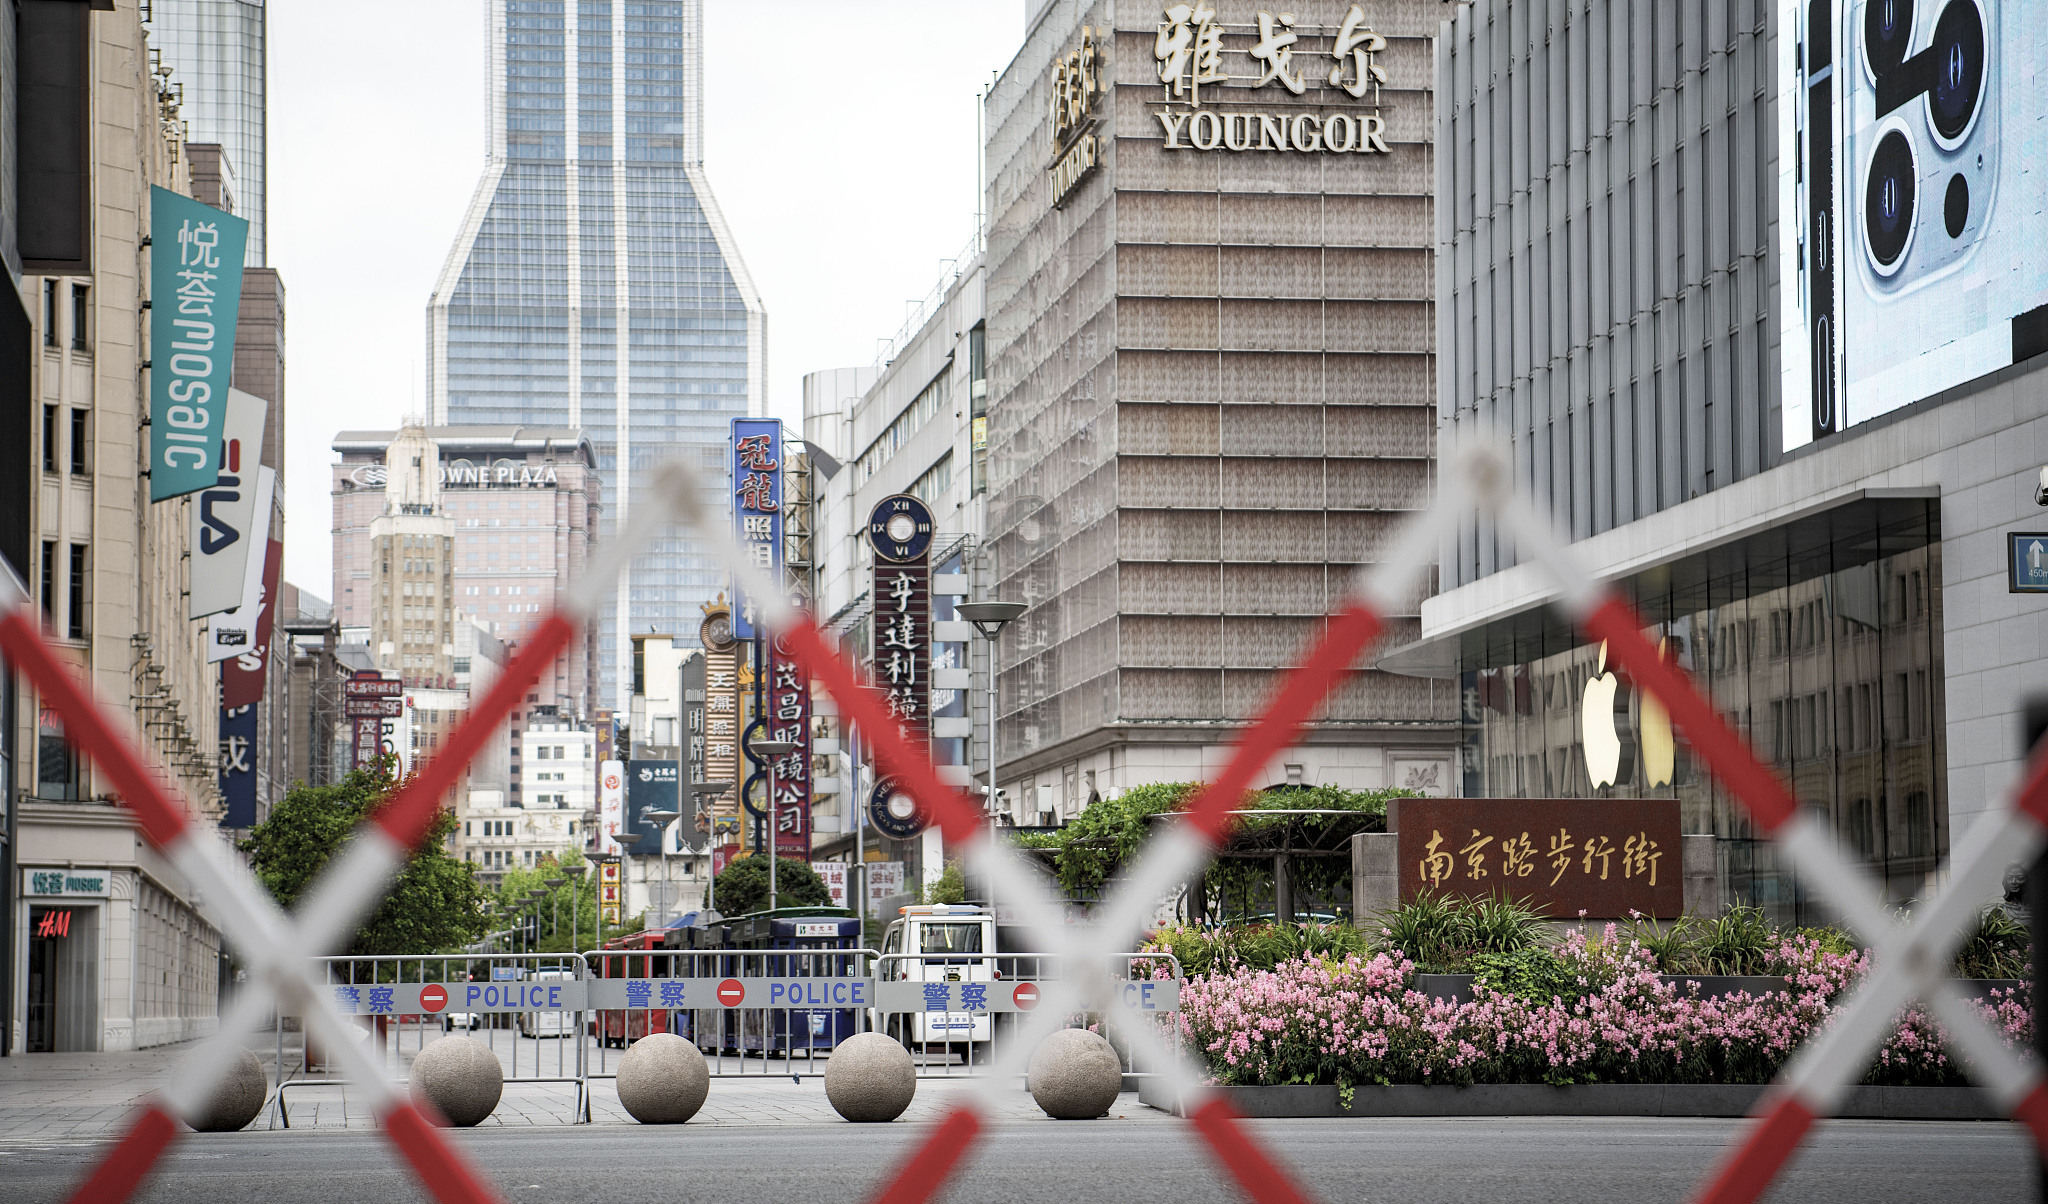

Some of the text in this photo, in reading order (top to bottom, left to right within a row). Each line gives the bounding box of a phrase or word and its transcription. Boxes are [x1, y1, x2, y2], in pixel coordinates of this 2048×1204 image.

[1154, 3, 1390, 108] 雅戈尔
[1155, 112, 1393, 154] YOUNGOR
[176, 219, 220, 318] 悦荟
[498, 466, 558, 484] PLAZA
[892, 501, 910, 511] XII
[872, 523, 885, 533] IX
[918, 523, 930, 533] III
[895, 546, 908, 555] VI
[386, 702, 401, 715] 9F
[711, 672, 731, 759] 王開照相
[1419, 828, 1663, 889] 南京路步行街
[38, 910, 71, 938] H&M
[848, 966, 853, 976] 2
[334, 986, 395, 1014] 警察
[466, 985, 562, 1008] POLICE
[626, 980, 685, 1007] 警察
[770, 982, 865, 1004] POLICE
[923, 982, 987, 1011] 警察
